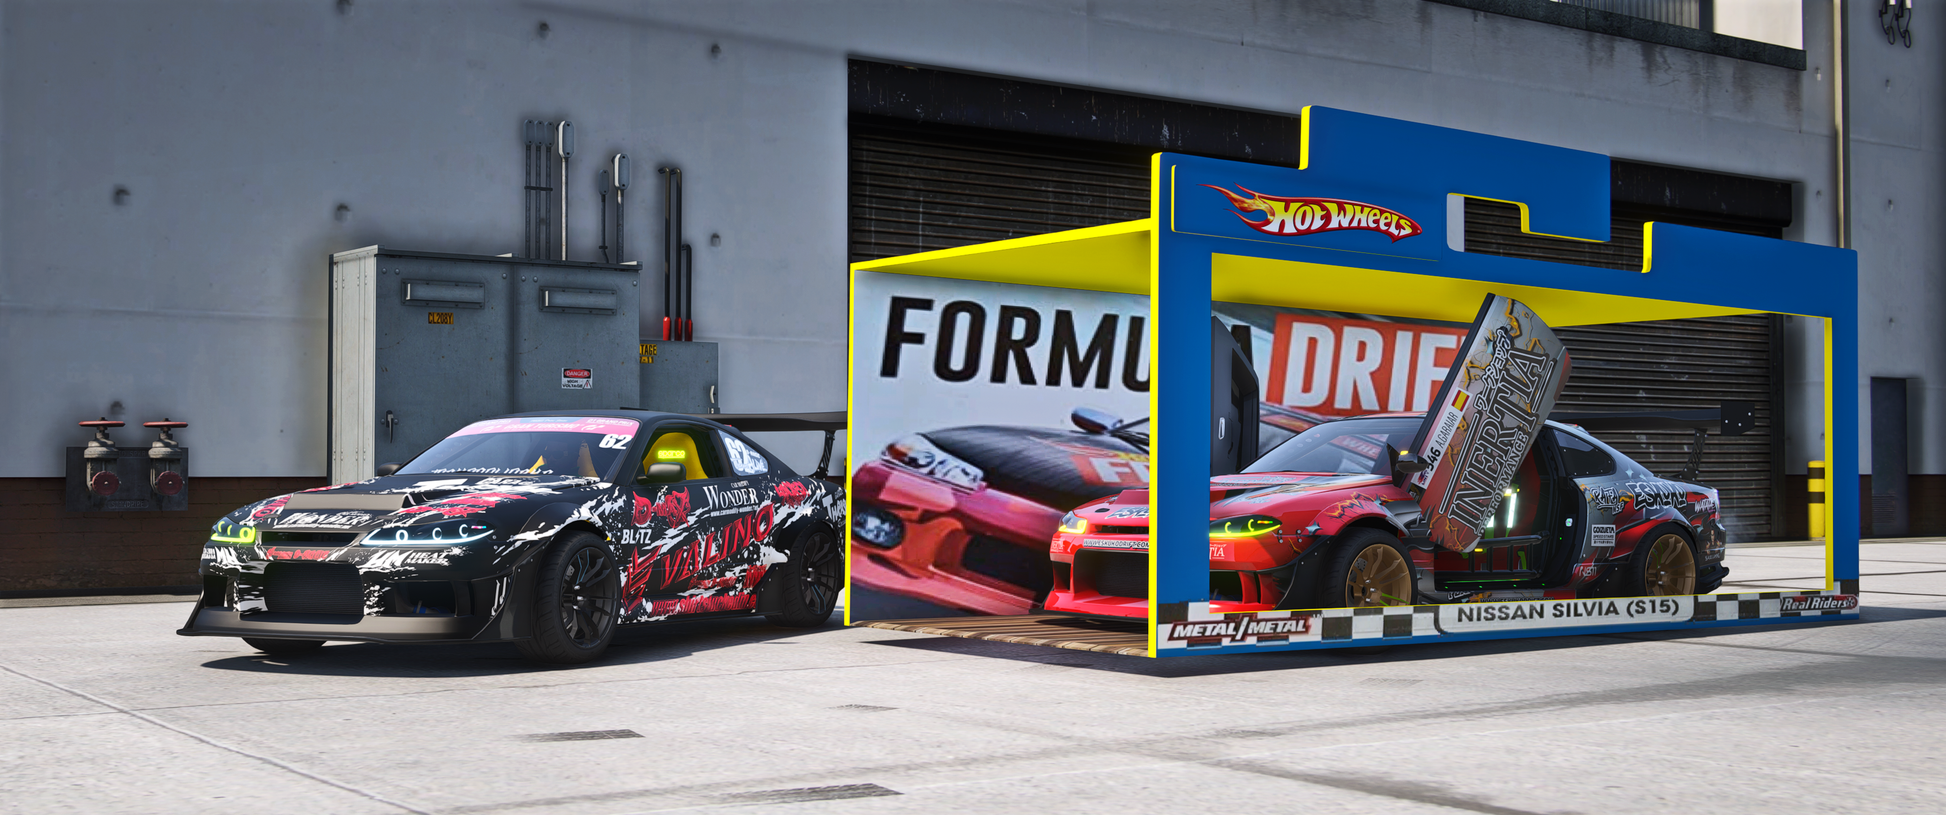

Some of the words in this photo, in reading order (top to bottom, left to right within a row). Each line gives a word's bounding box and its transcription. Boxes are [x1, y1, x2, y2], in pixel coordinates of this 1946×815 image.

[1283, 321, 1467, 413] DRIF
[598, 433, 633, 450] 62
[1448, 350, 1549, 534] INERTIA
[1478, 431, 1529, 537] PERFORMANCE
[660, 502, 775, 590] VALINO
[1457, 603, 1545, 623] NISSAN
[1551, 599, 1620, 619] SILVIA
[1626, 597, 1680, 619] (S15)
[1782, 596, 1810, 610] Real
[1811, 595, 1847, 610] Riders
